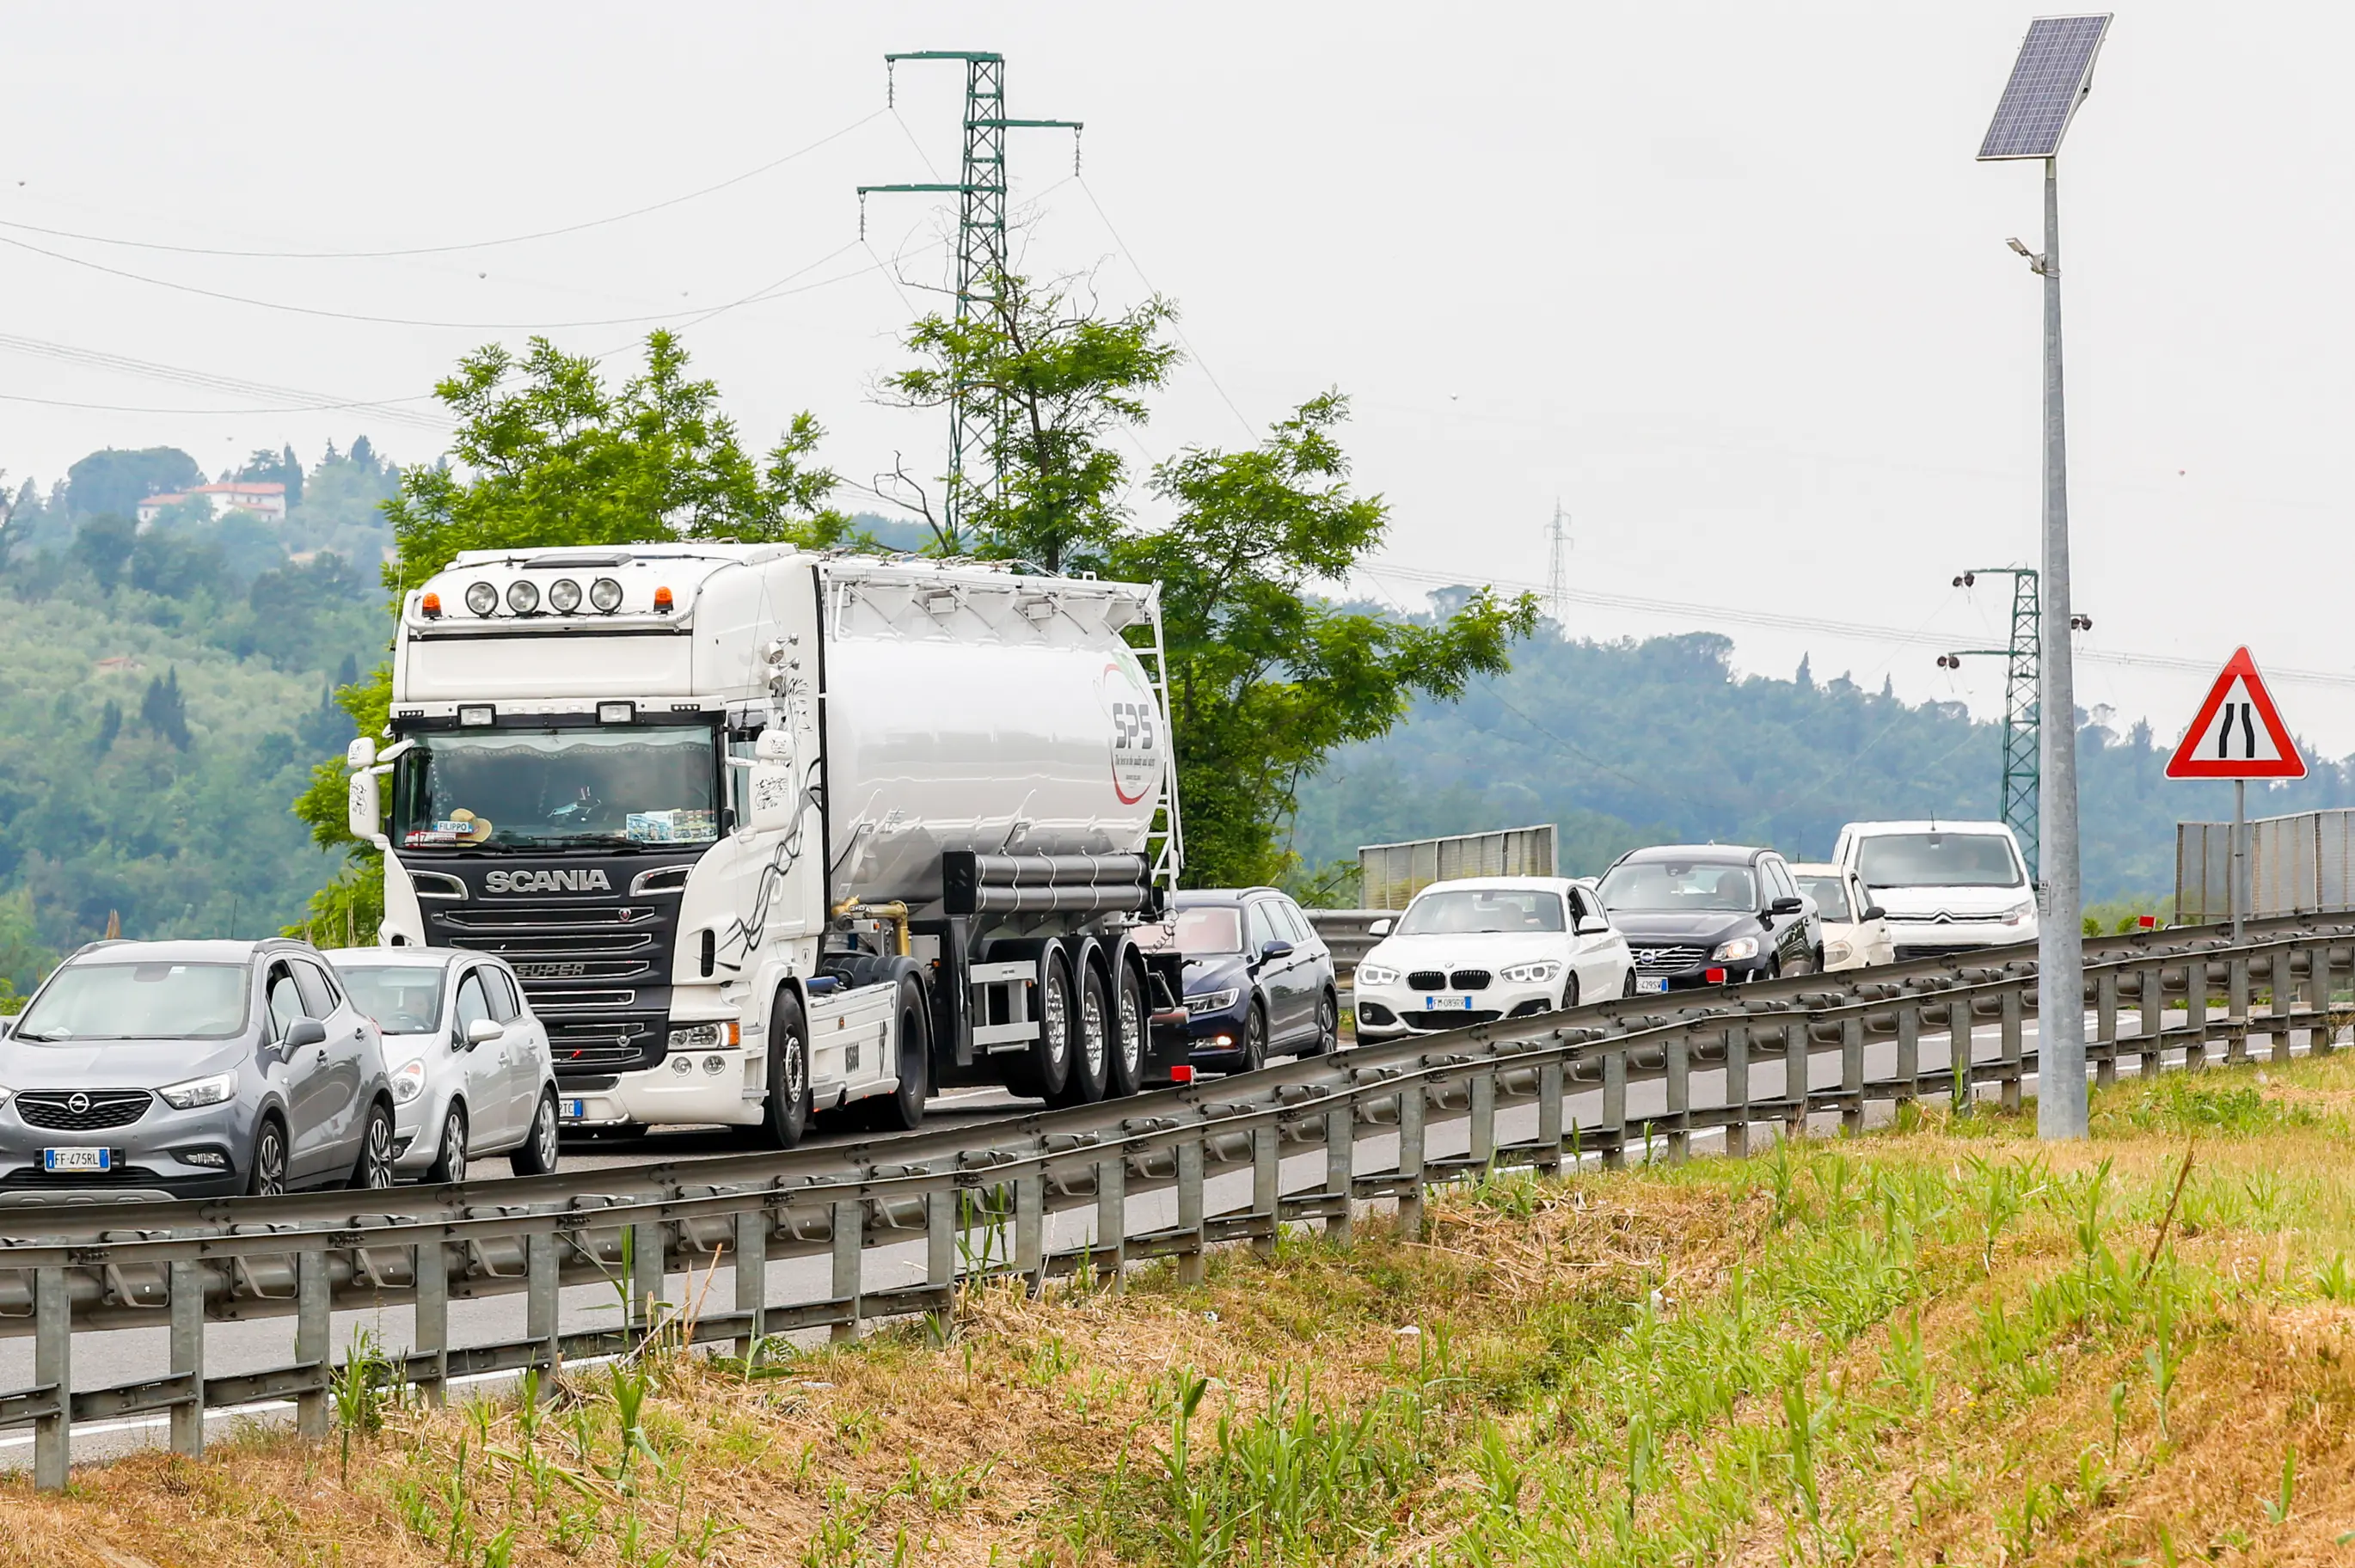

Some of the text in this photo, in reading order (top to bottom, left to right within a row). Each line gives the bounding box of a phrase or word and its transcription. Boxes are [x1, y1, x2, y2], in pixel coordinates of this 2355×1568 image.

[1113, 703, 1153, 749] SPS
[438, 823, 467, 831] FILIPPO
[485, 869, 612, 893] SCANIA
[517, 964, 585, 977] SUPER
